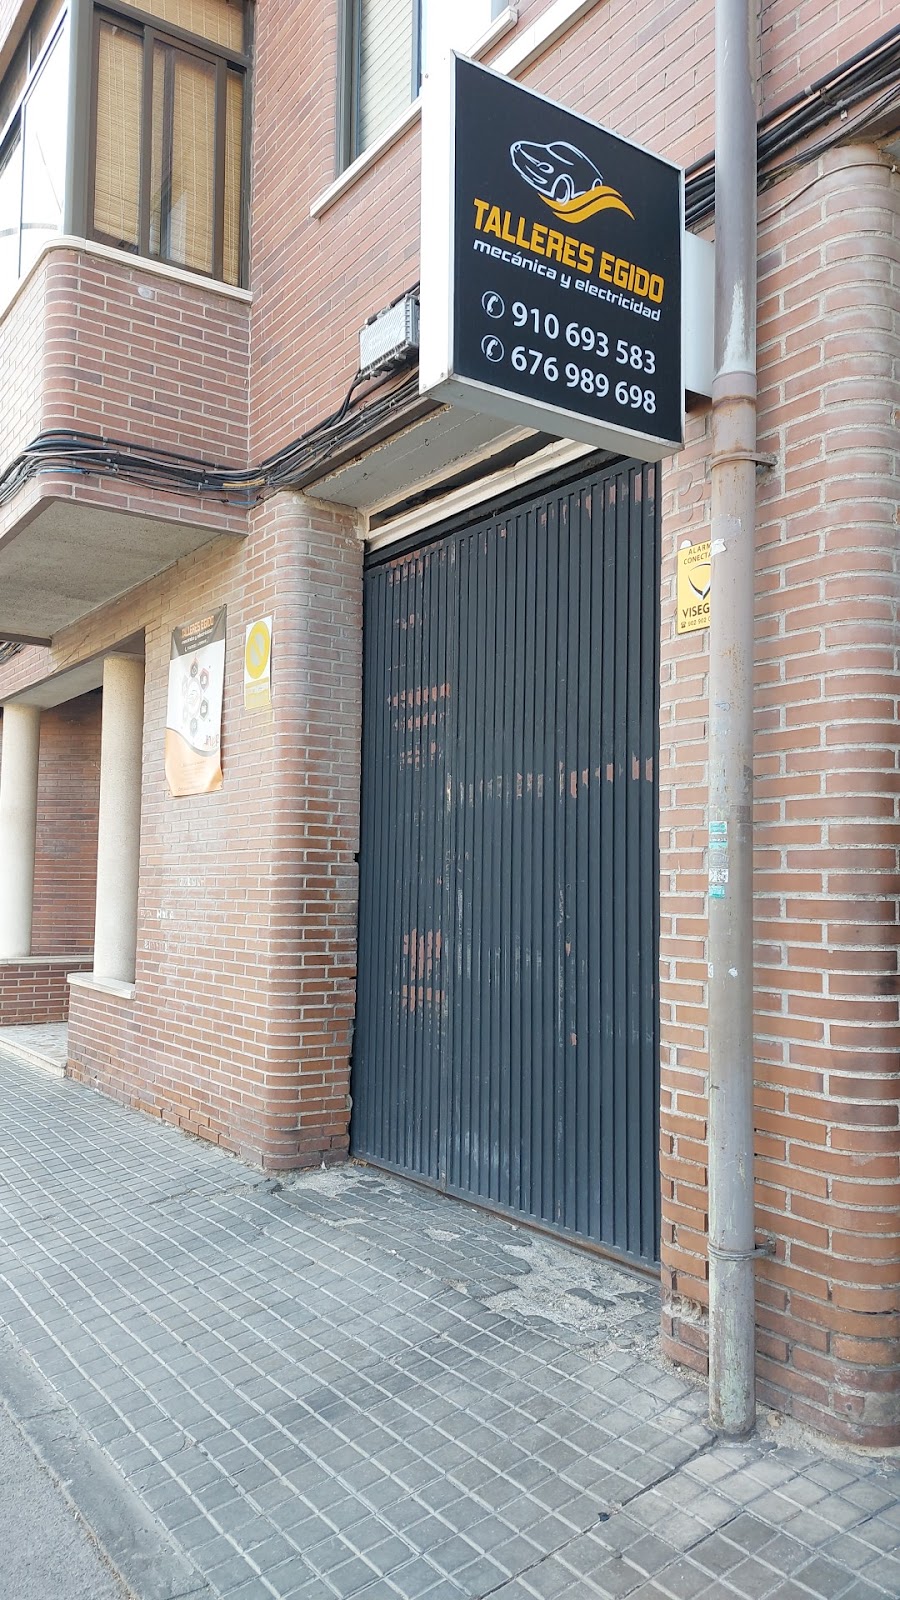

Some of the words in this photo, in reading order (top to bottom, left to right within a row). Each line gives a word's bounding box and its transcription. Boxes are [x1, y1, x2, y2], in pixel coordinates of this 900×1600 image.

[473, 198, 595, 274] TALLERES
[599, 251, 665, 303] EGIDO
[473, 239, 557, 280] mecánica
[560, 274, 572, 289] y
[575, 278, 662, 322] electricidad
[511, 302, 559, 340] 910
[565, 323, 609, 357] 693
[616, 340, 656, 375] 583
[511, 346, 559, 382] 676
[565, 363, 609, 397] 989
[615, 381, 656, 414] 698
[682, 602, 710, 618] VISEG
